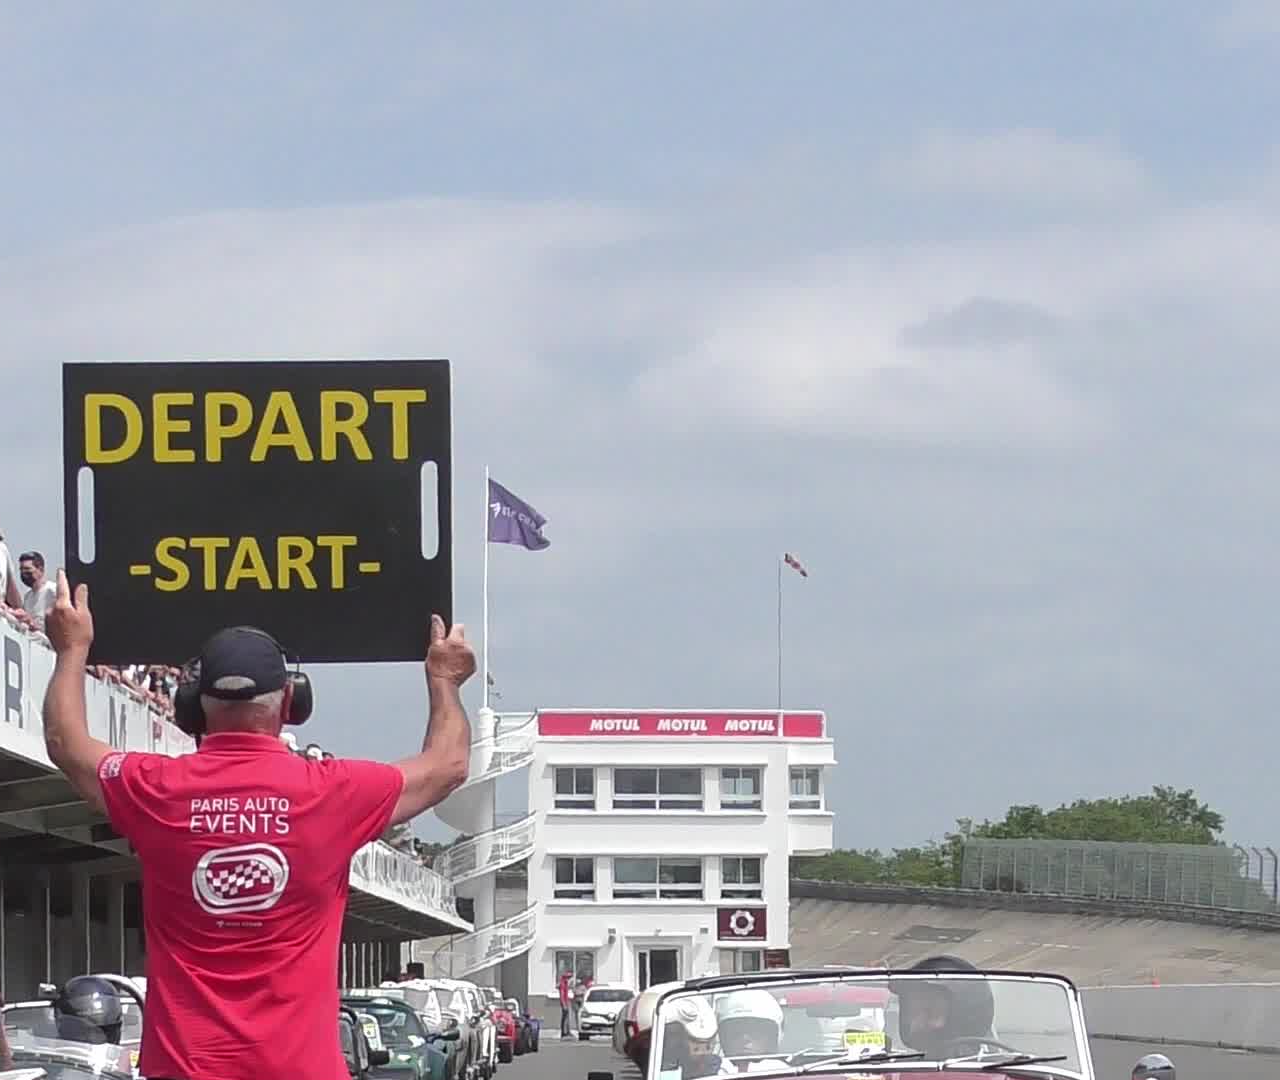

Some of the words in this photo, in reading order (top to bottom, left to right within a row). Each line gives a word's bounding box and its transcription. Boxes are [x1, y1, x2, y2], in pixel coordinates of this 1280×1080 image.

[84, 389, 427, 464] DEPART
[129, 536, 381, 591] -START-
[589, 719, 640, 731] MOTUL
[656, 719, 708, 731] MOTUL
[724, 719, 775, 731] MOTUL
[191, 797, 240, 812] PARIS
[244, 797, 289, 812] AUTO
[190, 813, 289, 834] EVENTS
